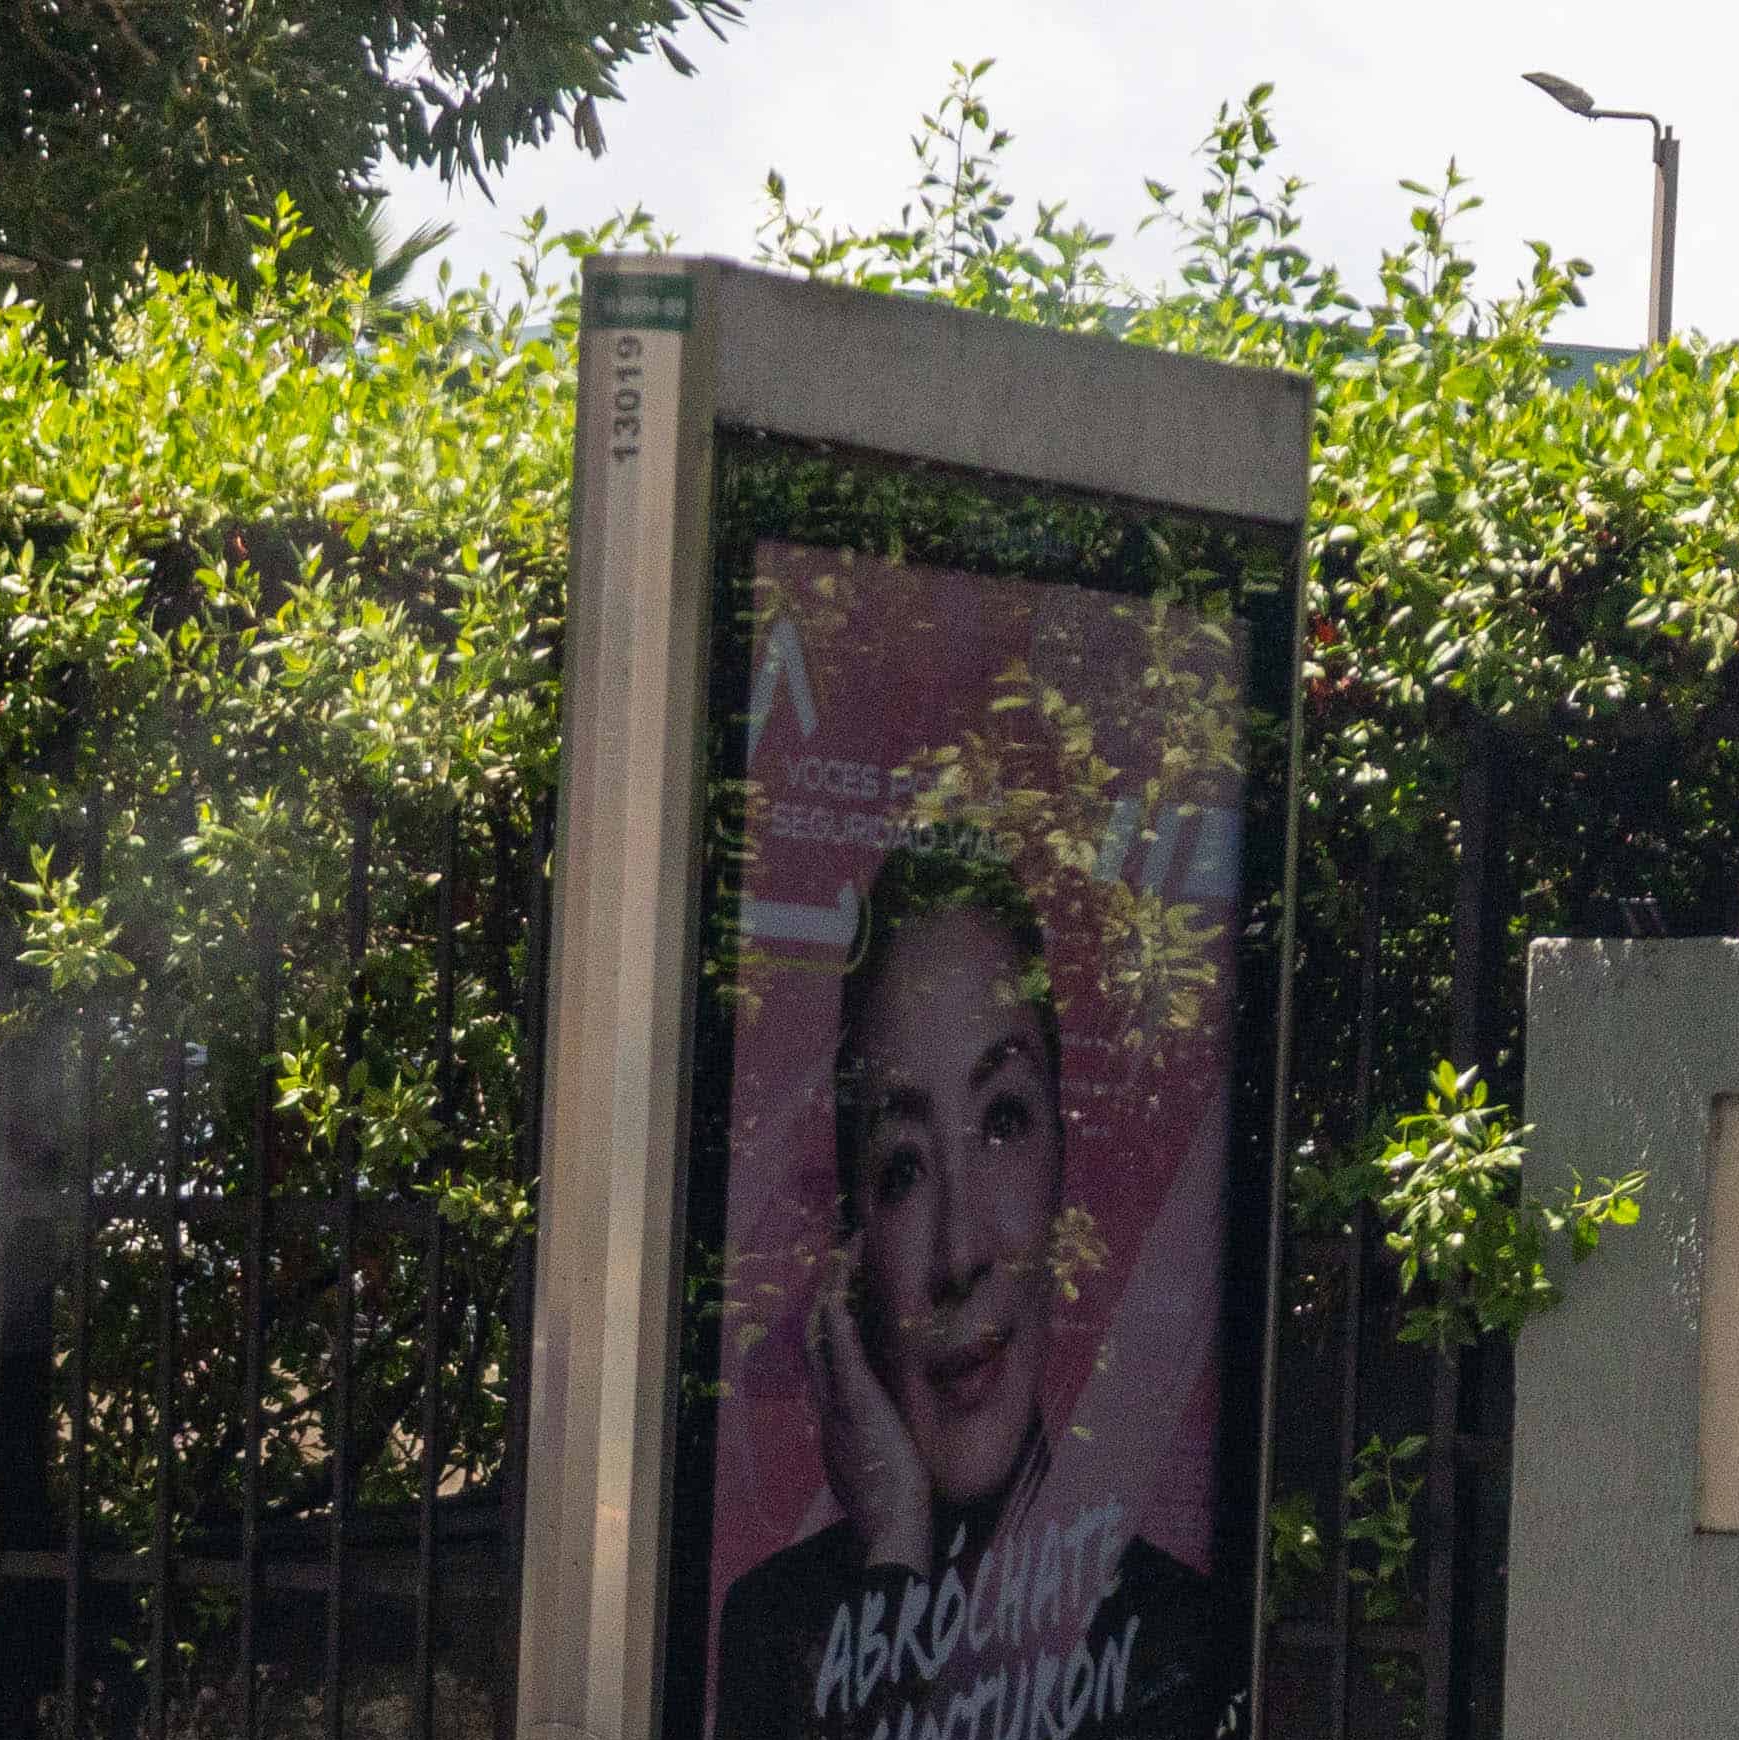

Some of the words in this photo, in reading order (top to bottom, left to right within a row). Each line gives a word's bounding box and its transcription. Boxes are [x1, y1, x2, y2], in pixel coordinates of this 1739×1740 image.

[612, 335, 643, 464] 13019
[786, 756, 880, 800] VOCES
[815, 1493, 1124, 1718] ABRÓCHATE
